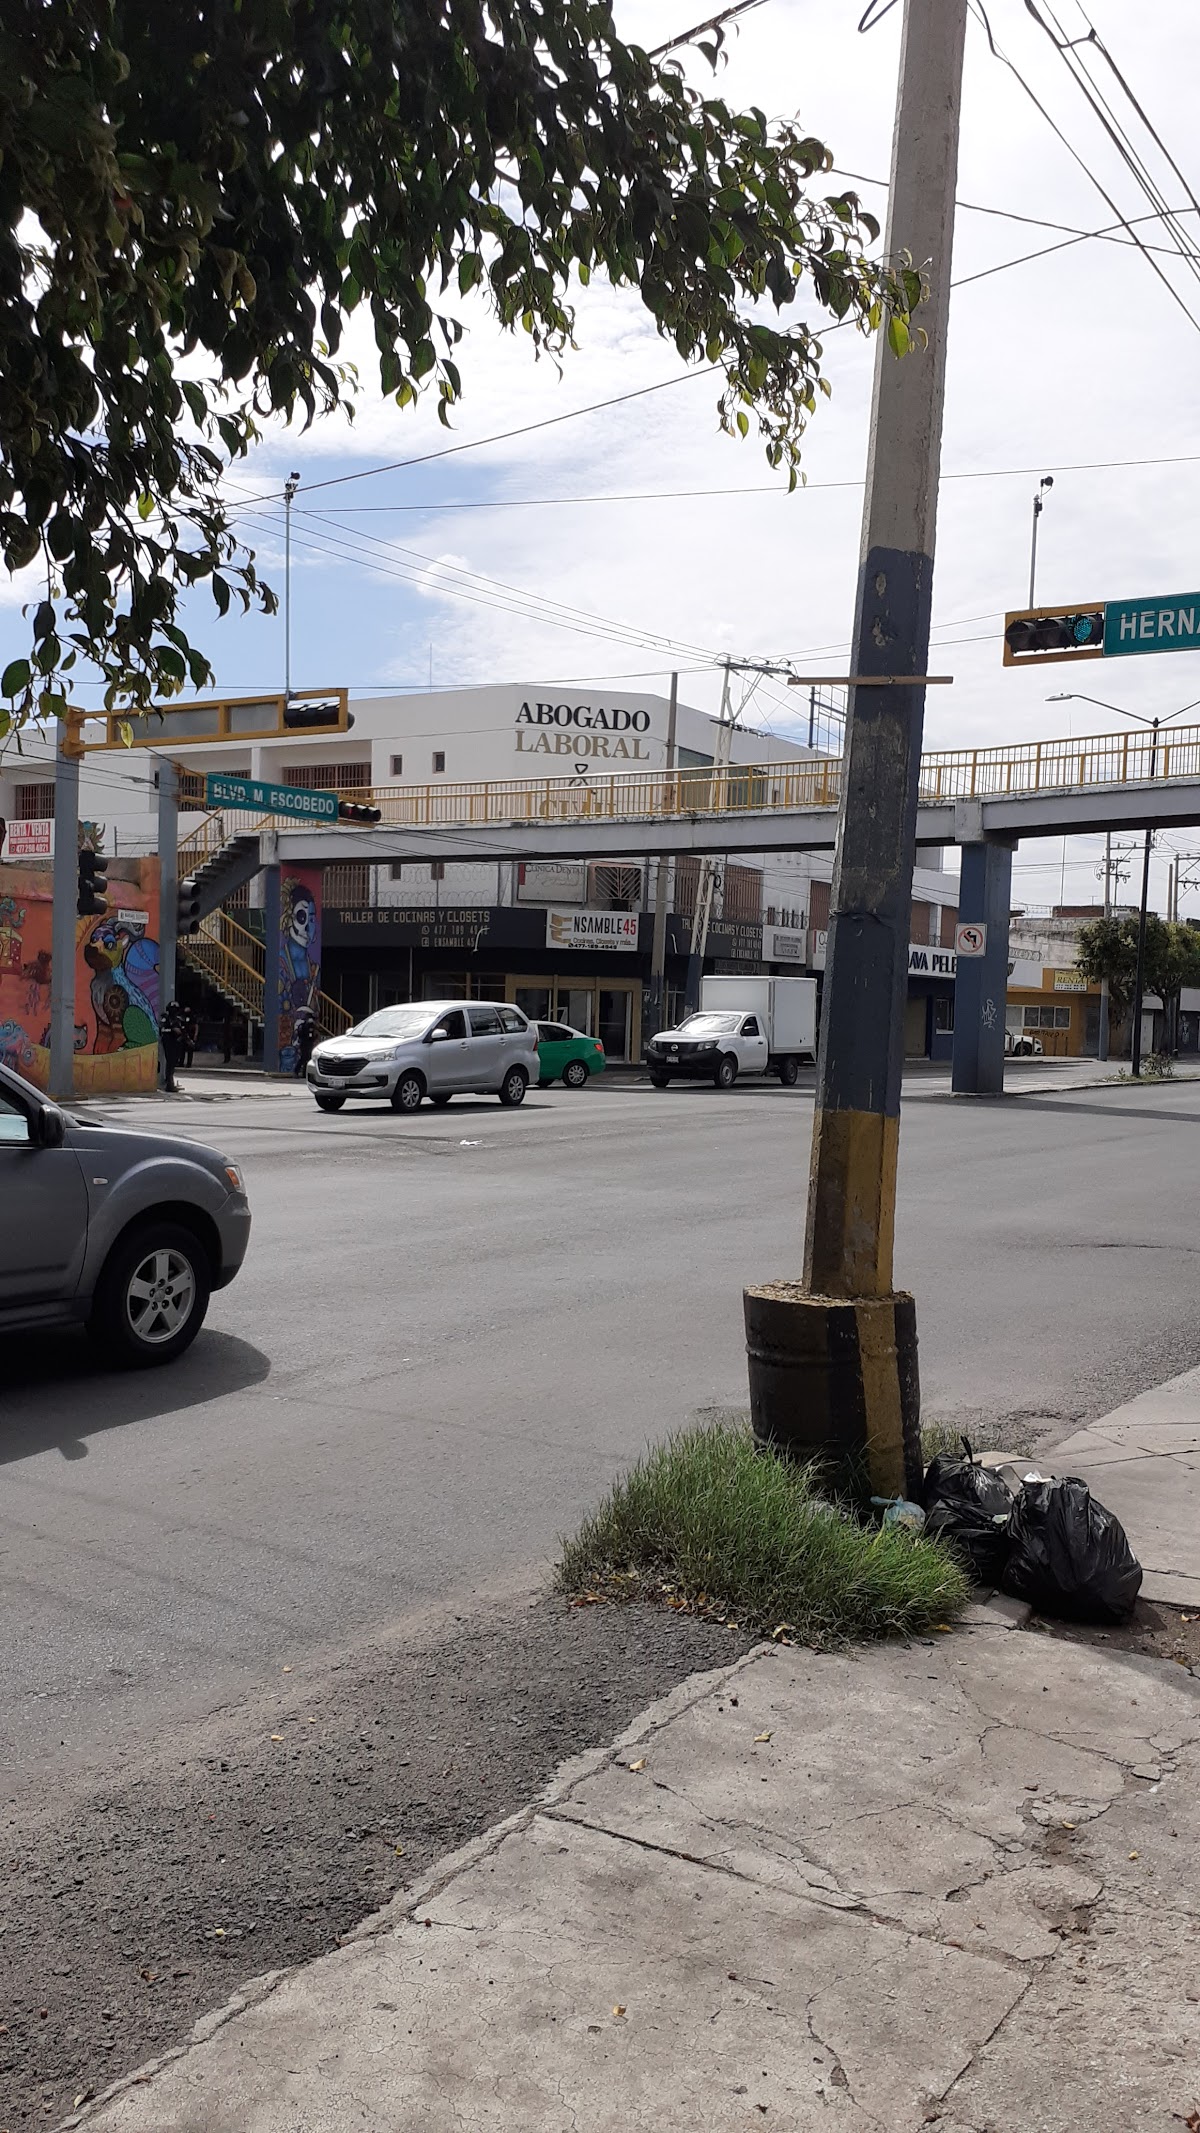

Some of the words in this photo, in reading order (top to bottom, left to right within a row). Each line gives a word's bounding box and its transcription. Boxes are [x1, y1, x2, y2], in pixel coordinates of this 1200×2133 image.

[1120, 607, 1200, 640] HERN
[515, 702, 650, 732] ABOGADO
[515, 730, 650, 760] LABORAL
[213, 783, 249, 803] BLVD.
[270, 791, 334, 814] ESCOBEDO
[10, 823, 26, 837] RENTA
[32, 822, 49, 836] VENTA
[339, 911, 373, 923] TALLER
[378, 911, 389, 923] DE
[393, 911, 435, 923] COCINAS
[438, 911, 445, 922] Y
[447, 911, 490, 923] CLOSETS
[434, 925, 447, 935] 477
[682, 918, 702, 932] TALLR
[711, 922, 735, 935] COCINAS
[740, 926, 762, 938] CLOSETS
[1056, 976, 1084, 984] RENTA
